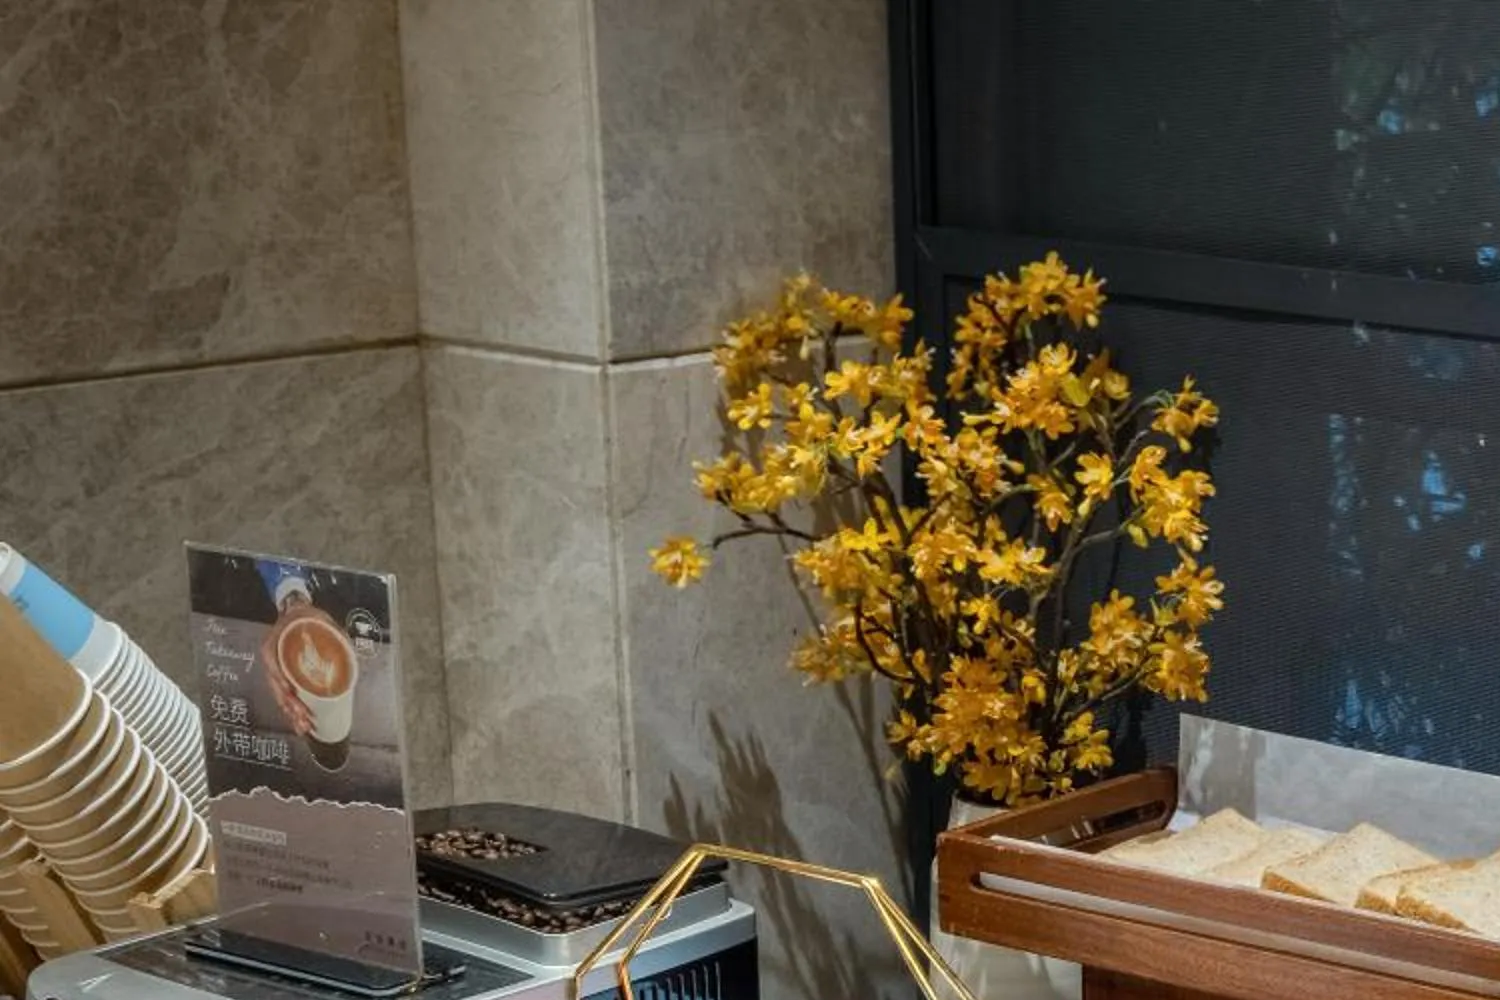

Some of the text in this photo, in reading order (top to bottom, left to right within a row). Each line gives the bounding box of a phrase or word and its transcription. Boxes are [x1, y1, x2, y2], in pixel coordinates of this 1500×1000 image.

[210, 694, 249, 723] 免费
[211, 727, 290, 765] 外带咖啡
